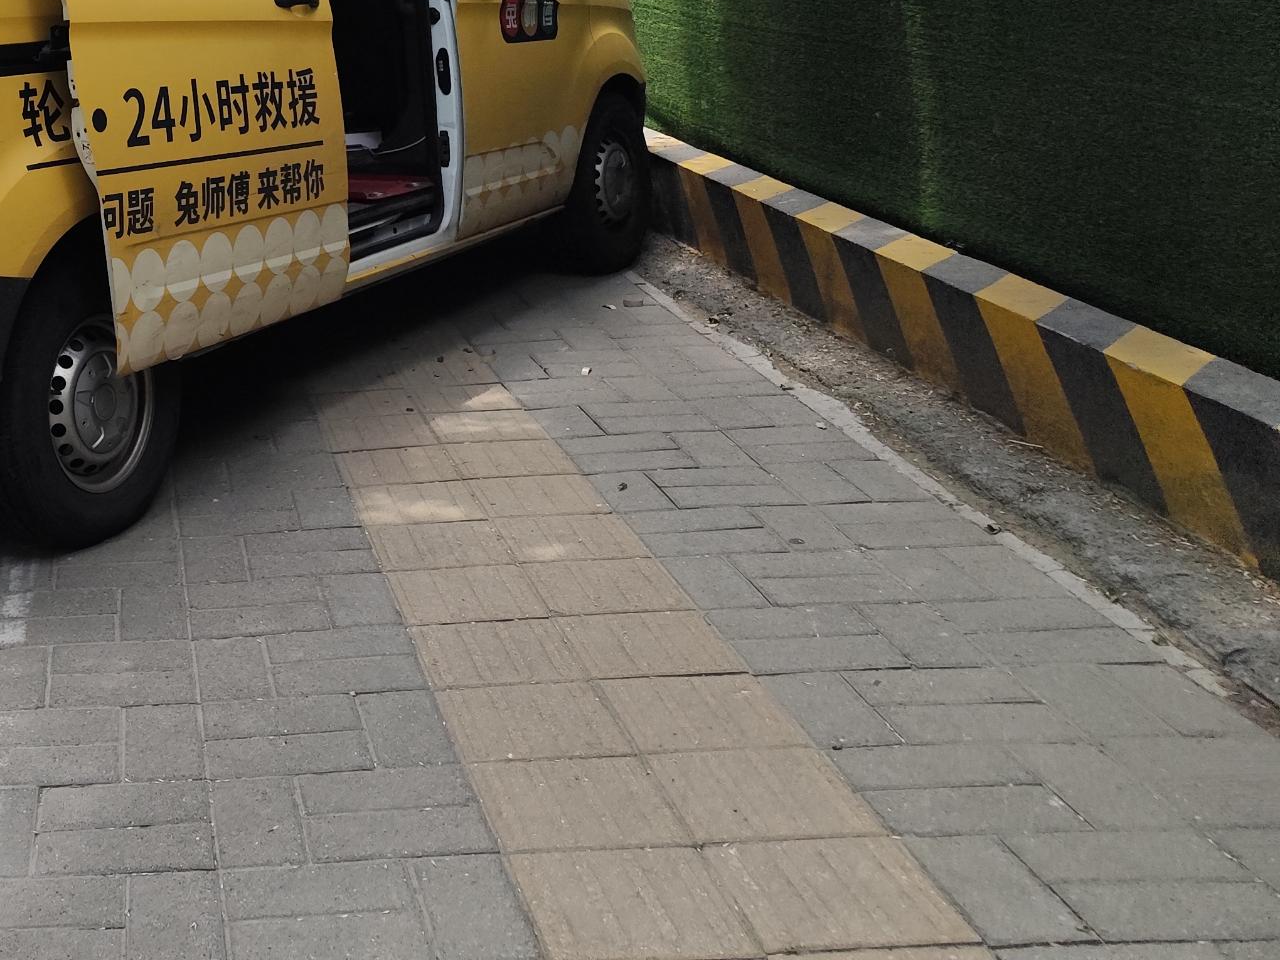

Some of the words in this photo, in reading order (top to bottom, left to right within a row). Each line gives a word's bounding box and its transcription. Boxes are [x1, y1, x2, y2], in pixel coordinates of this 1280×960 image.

[174, 171, 251, 227] 兔师傅
[257, 159, 325, 210] 来帮你
